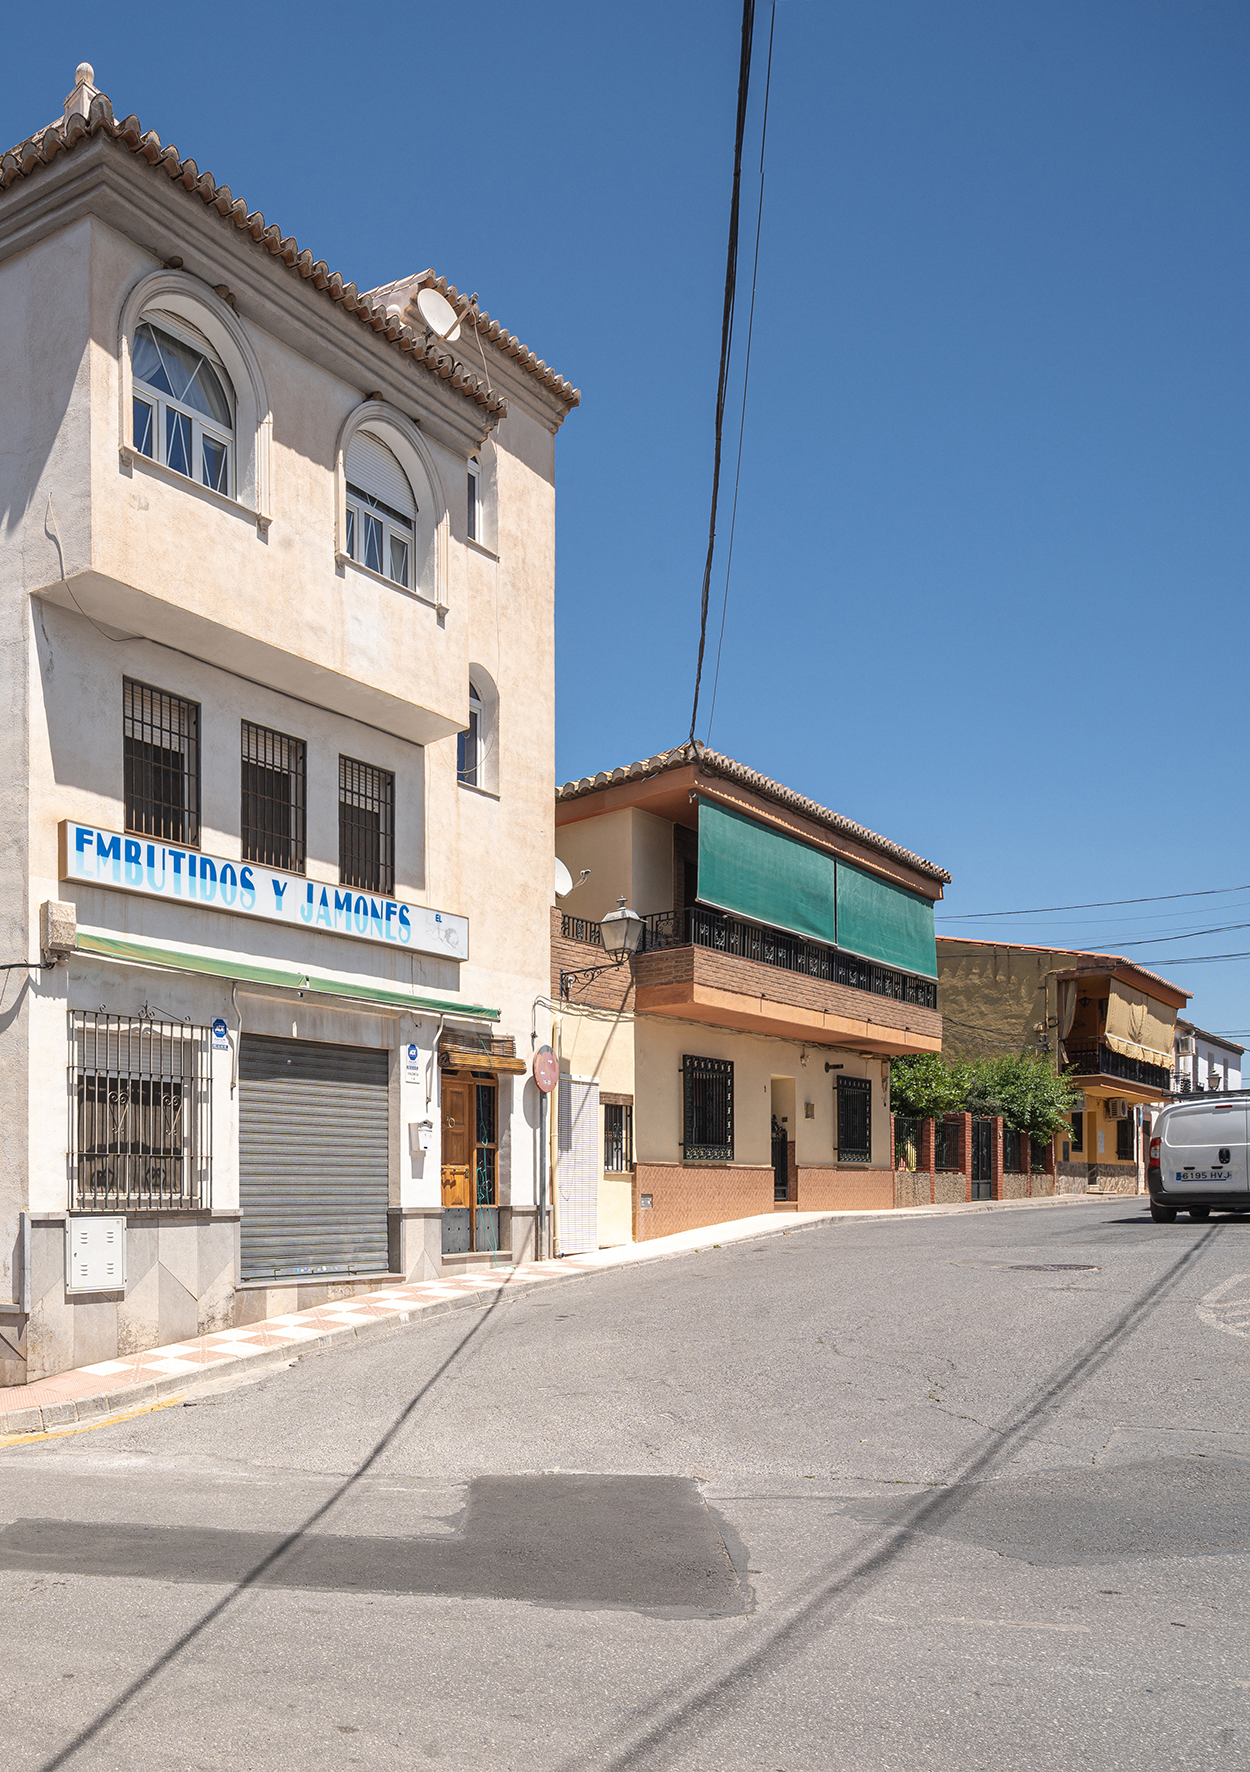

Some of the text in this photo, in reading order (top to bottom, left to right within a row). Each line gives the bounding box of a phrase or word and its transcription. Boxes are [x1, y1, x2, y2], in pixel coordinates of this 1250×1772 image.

[75, 827, 411, 944] EMBUTIDOS Y JAMONES
[435, 913, 442, 923] EL
[1182, 1171, 1230, 1180] 6195 HVJ
